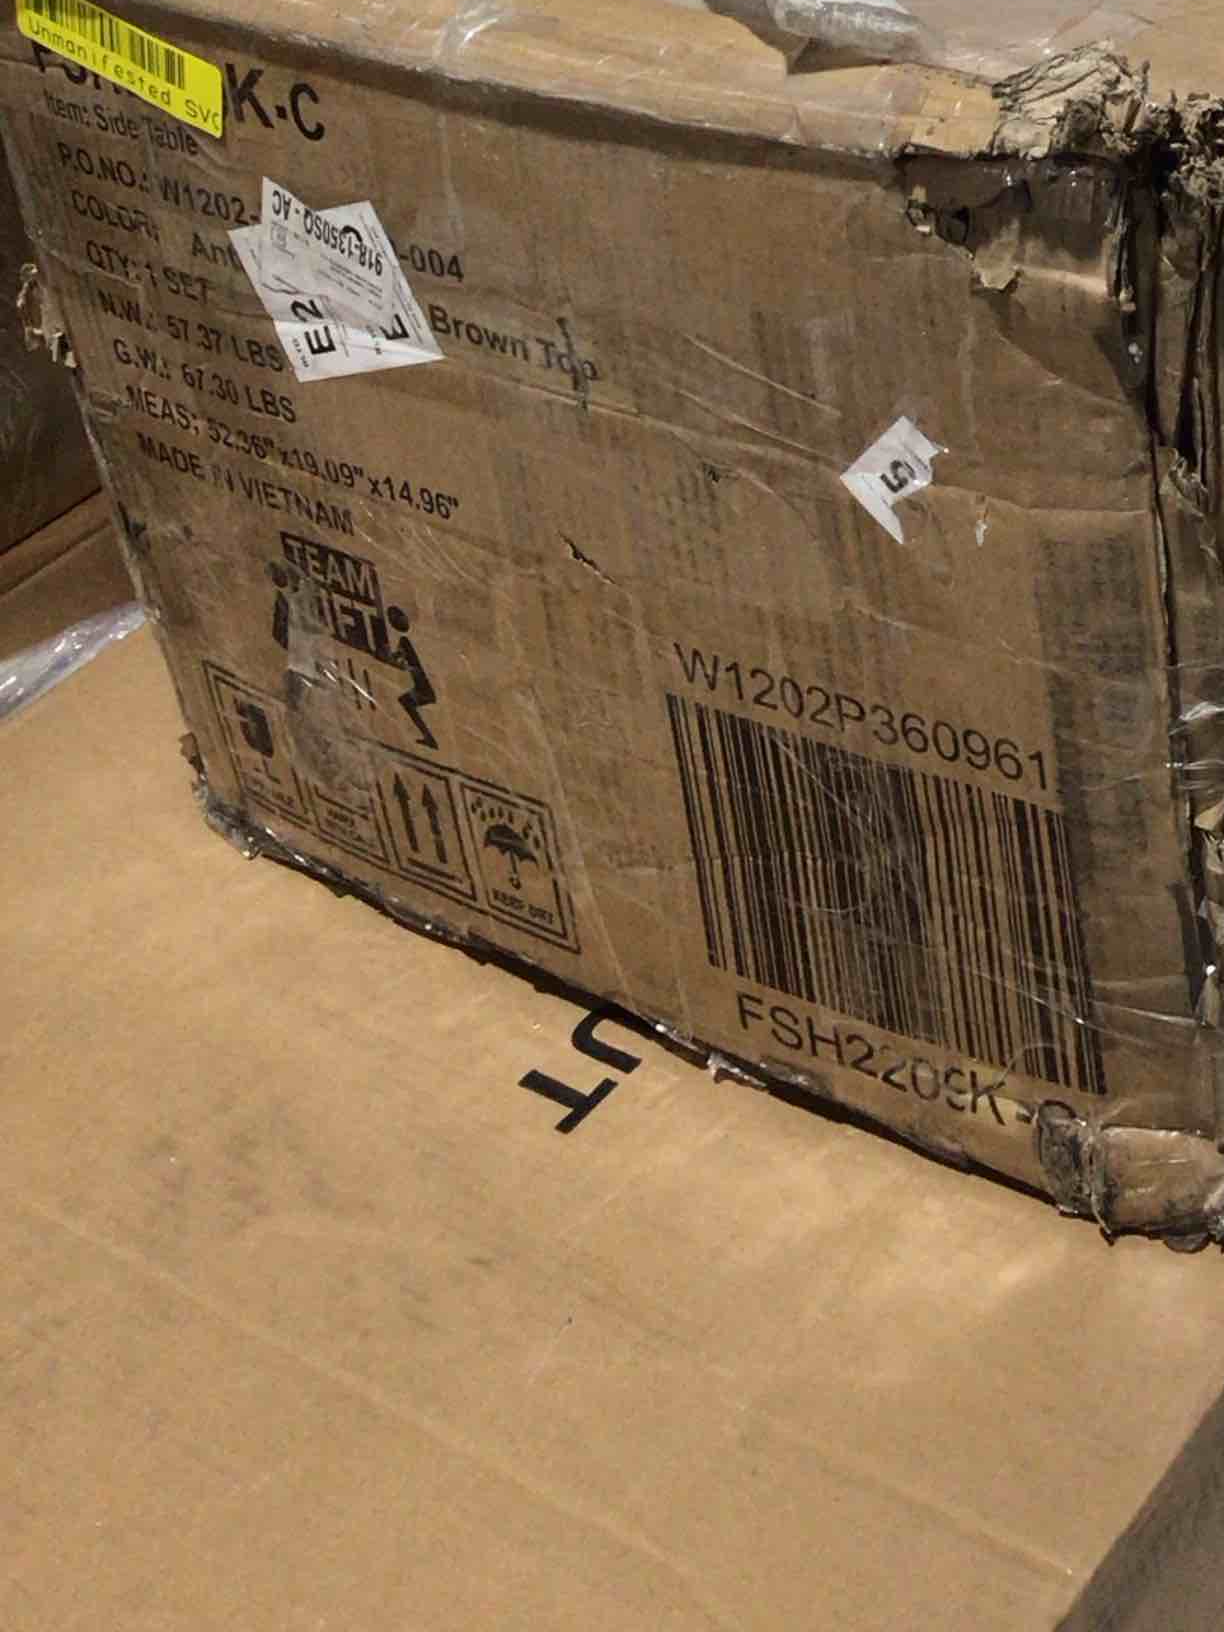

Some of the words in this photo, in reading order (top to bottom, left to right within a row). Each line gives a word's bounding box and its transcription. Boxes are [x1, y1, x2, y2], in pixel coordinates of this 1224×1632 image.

[29, 17, 173, 110] Unmanifested
[43, 93, 90, 131] Item:
[93, 98, 142, 140] Side
[143, 109, 200, 158] Table
[271, 189, 293, 222] AC
[159, 256, 214, 306] SET
[230, 329, 288, 374] LBS
[429, 303, 533, 361] Brown
[180, 356, 242, 406] 67.30
[244, 382, 298, 425] LBS
[135, 430, 207, 483] MADE
[239, 462, 358, 539] VIETNAM
[288, 539, 380, 601] TEAM
[672, 641, 1051, 792] W1202P360961
